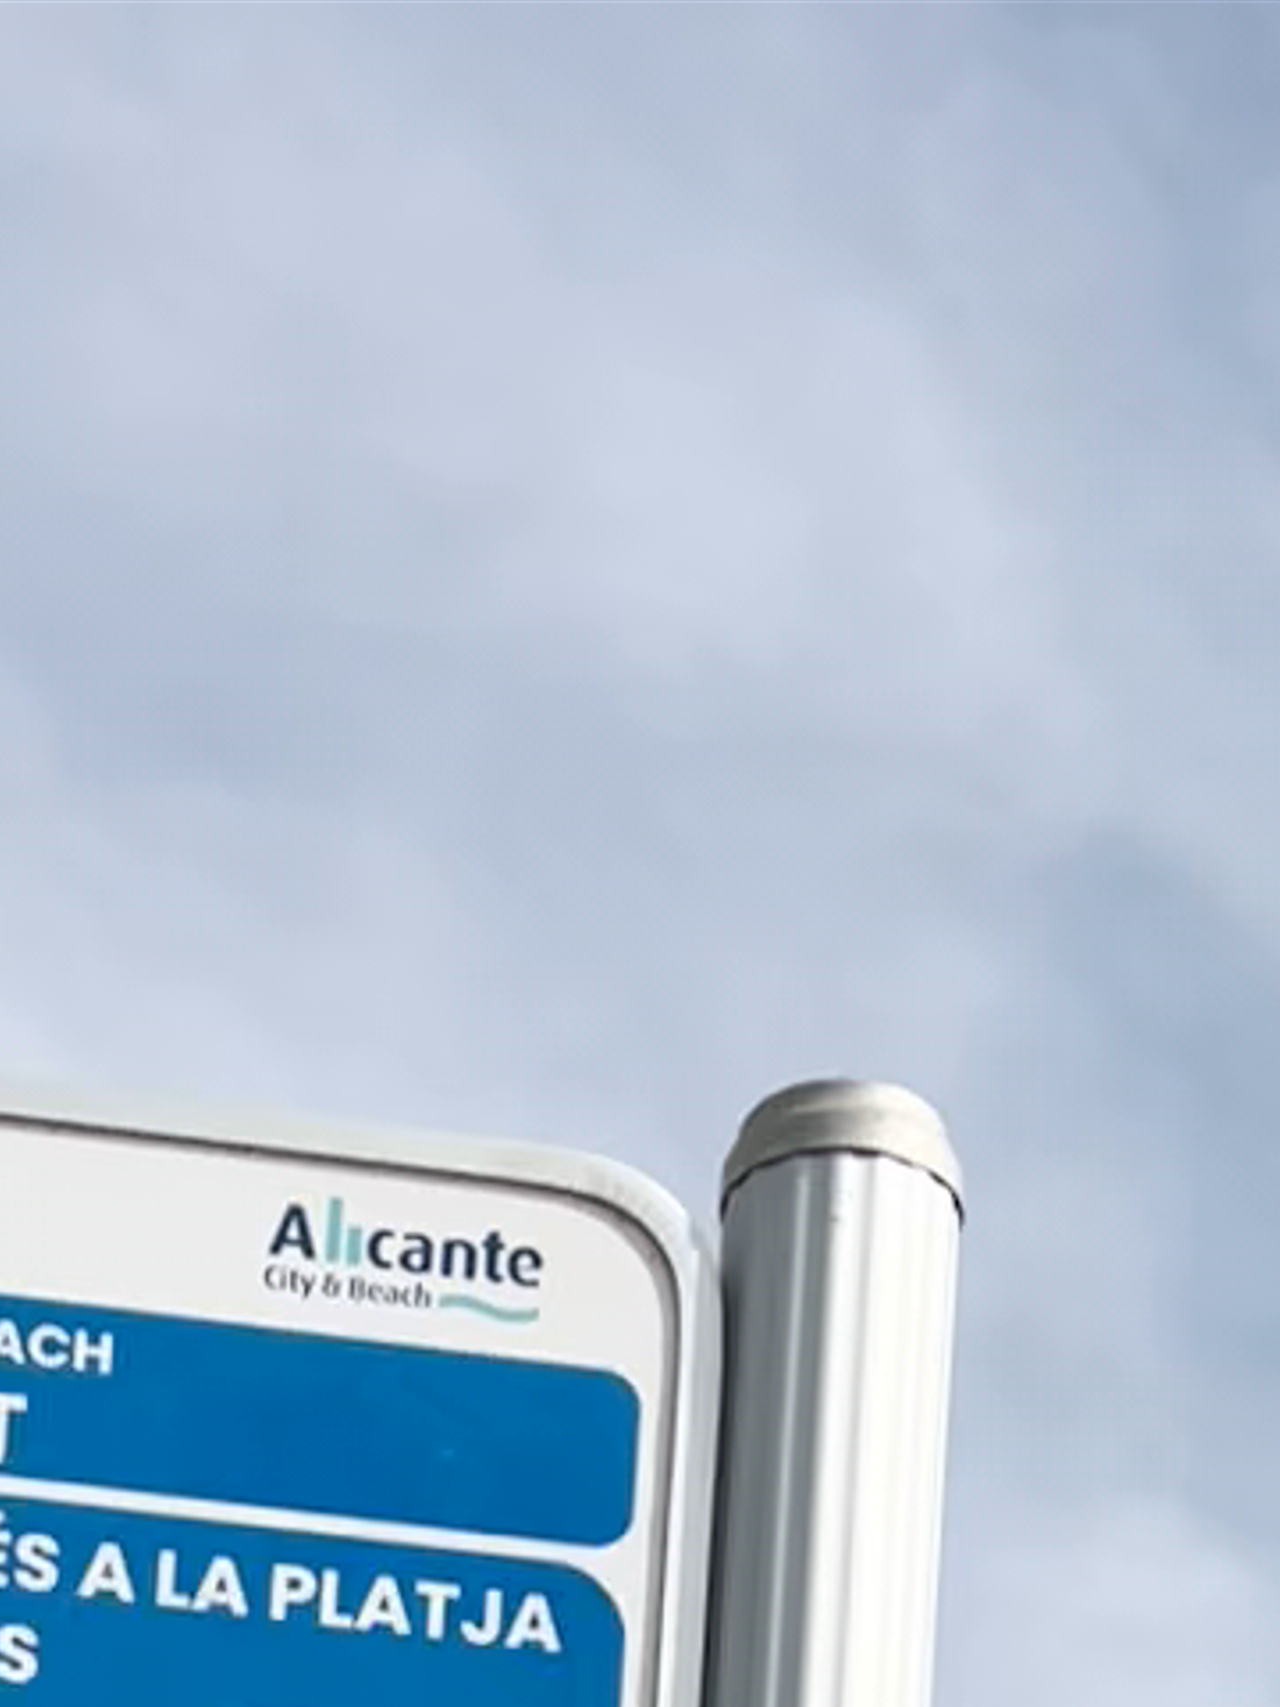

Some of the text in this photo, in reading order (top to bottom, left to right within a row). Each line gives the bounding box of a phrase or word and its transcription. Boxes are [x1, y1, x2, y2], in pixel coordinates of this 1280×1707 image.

[264, 1264, 432, 1308] City & Beach
[268, 1197, 543, 1287] Alicante
[78, 1544, 134, 1605] A
[154, 1550, 249, 1620] LA
[270, 1565, 560, 1654] PLATJA
